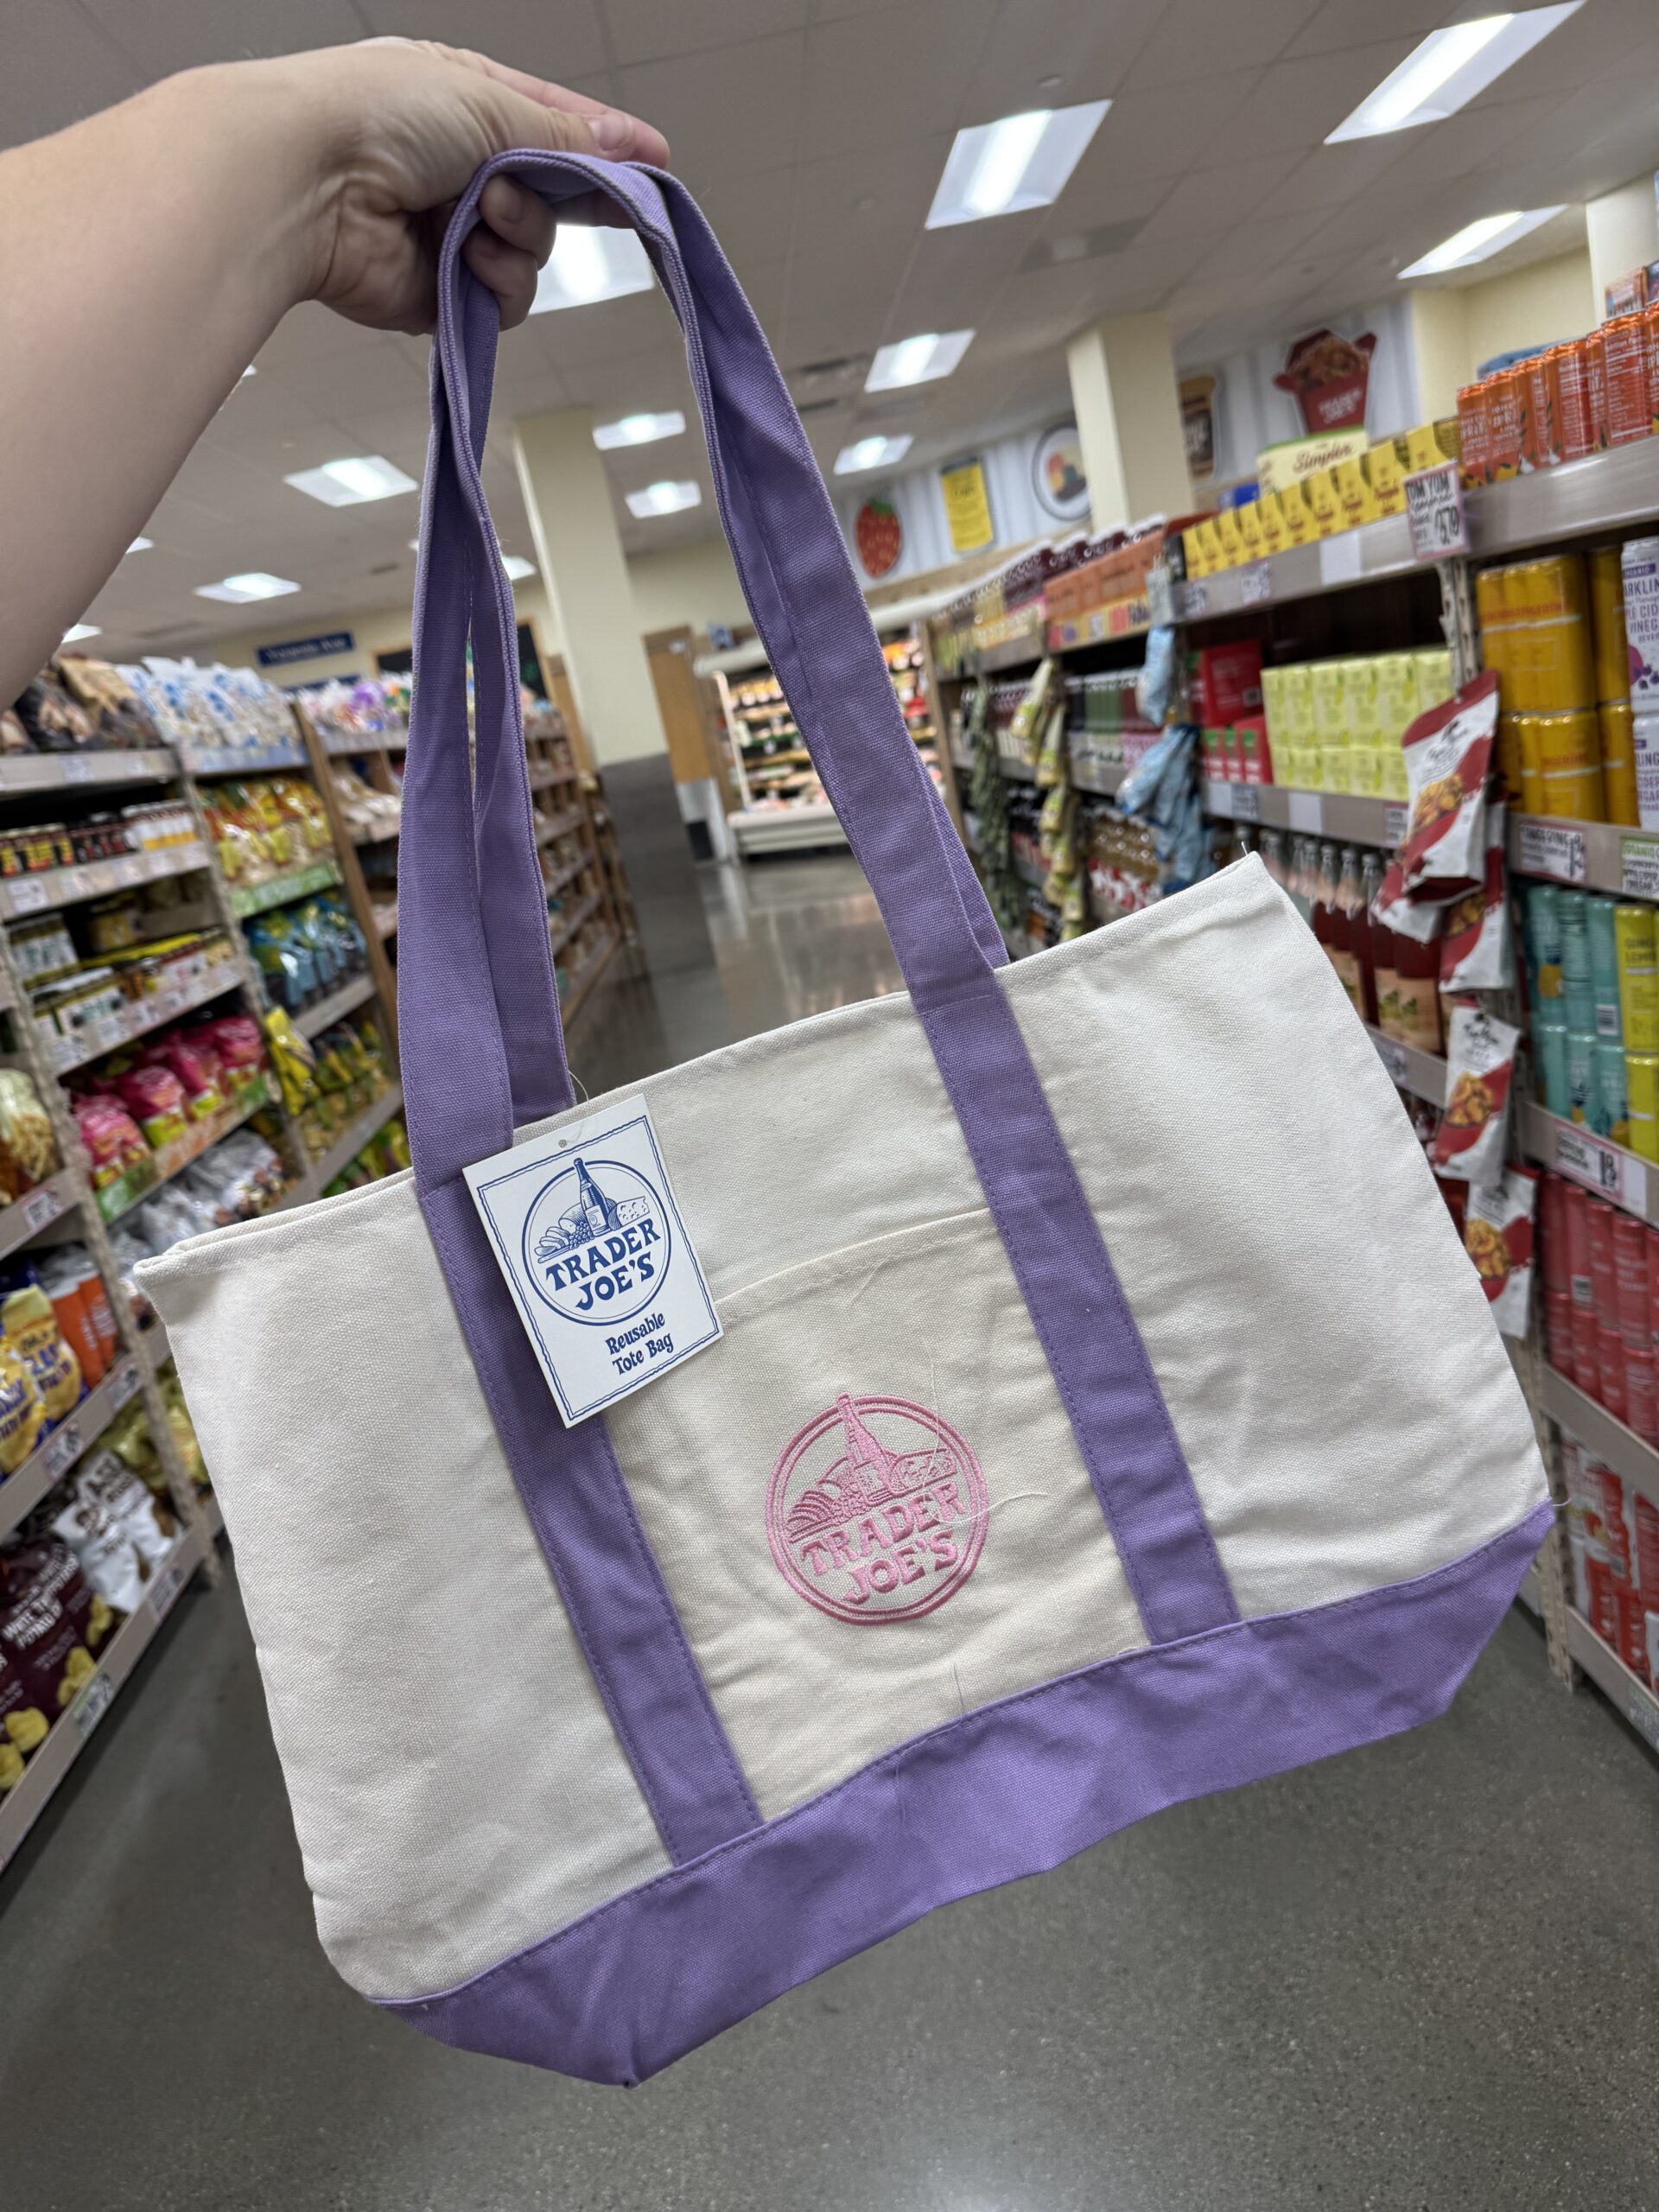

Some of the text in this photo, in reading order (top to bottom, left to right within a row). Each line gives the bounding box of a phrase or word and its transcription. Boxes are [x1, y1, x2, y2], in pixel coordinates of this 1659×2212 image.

[545, 1218, 661, 1291] TRADER
[575, 1251, 655, 1311] JOE'S
[605, 1313, 665, 1355] Reusable
[612, 1332, 674, 1376] Tote Bag
[801, 1482, 966, 1575] TRADER
[846, 1528, 958, 1605] JOE'S
